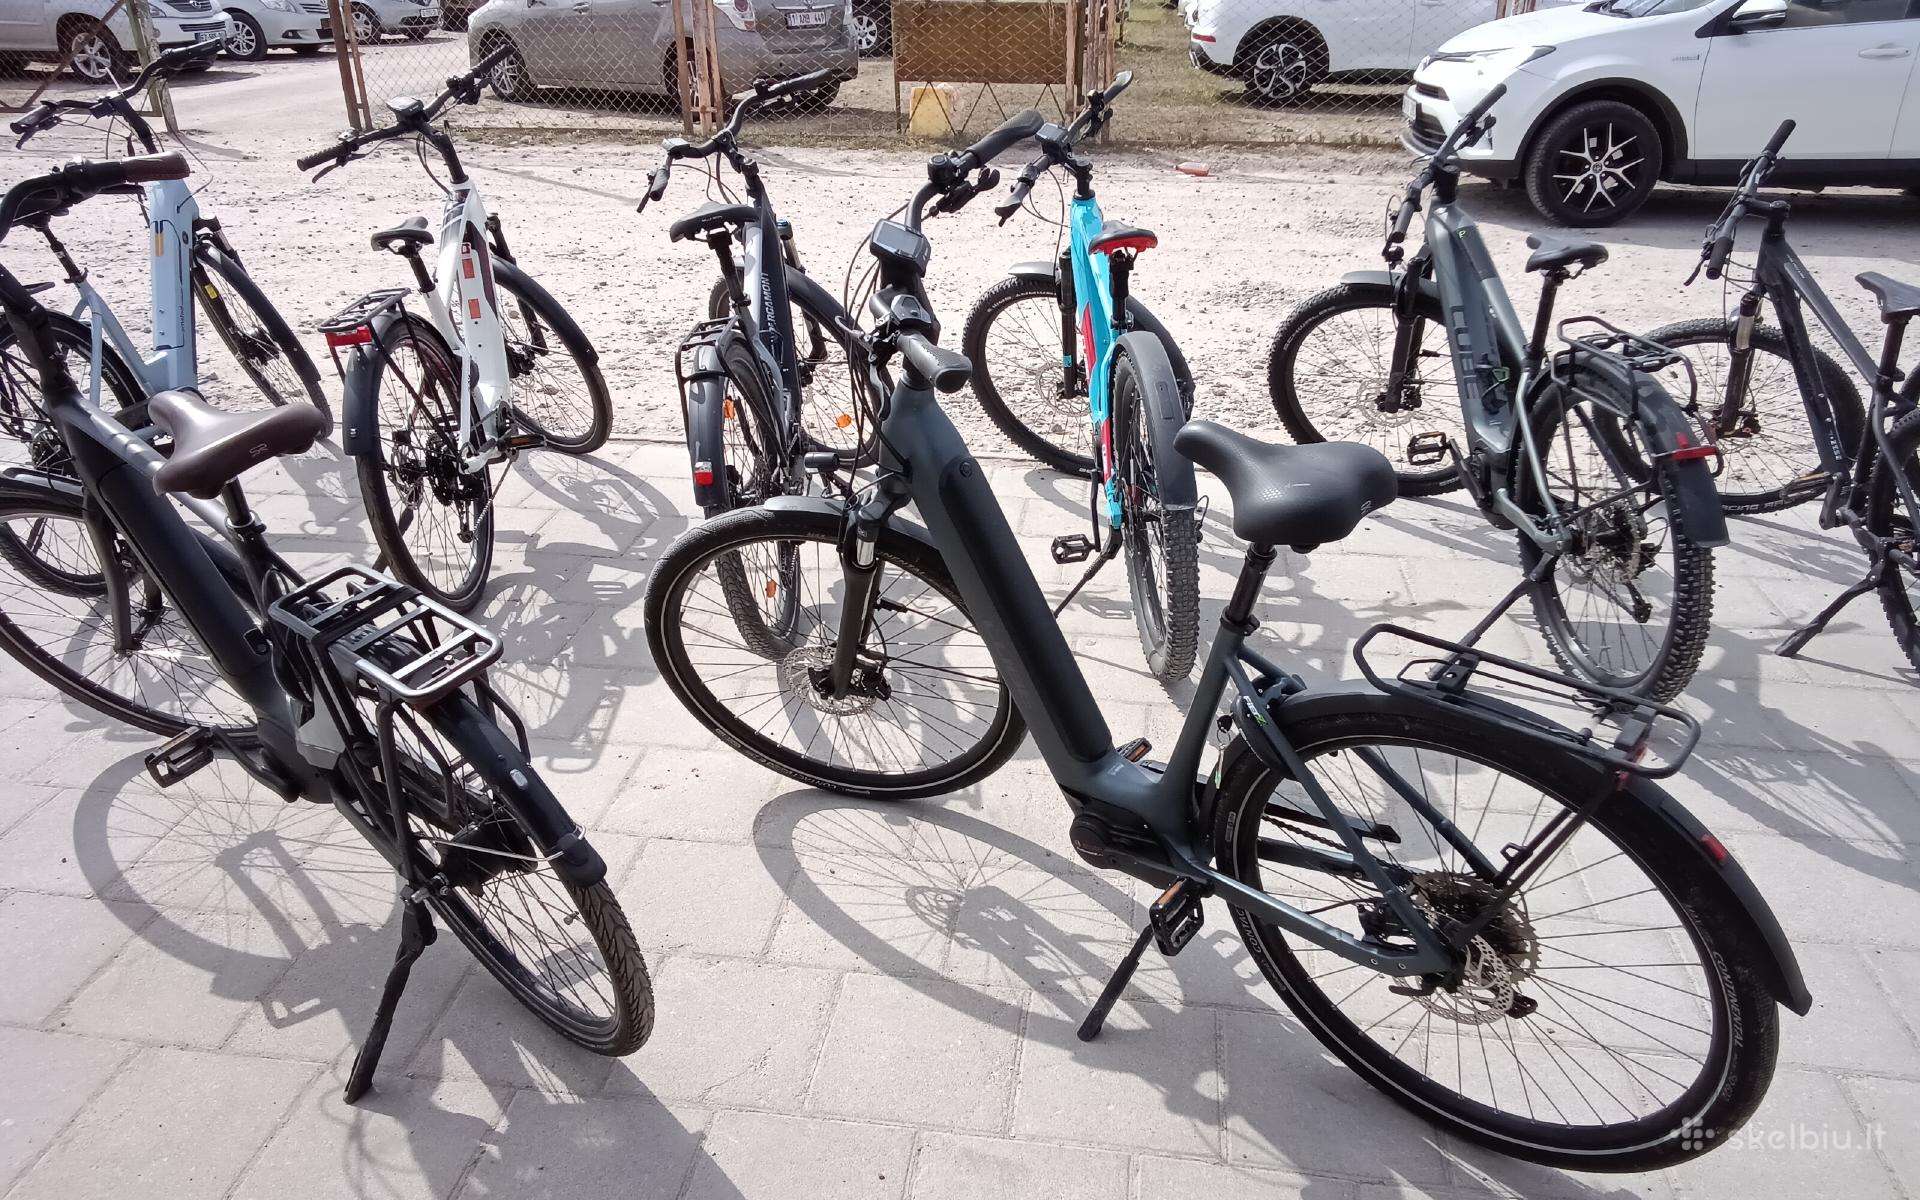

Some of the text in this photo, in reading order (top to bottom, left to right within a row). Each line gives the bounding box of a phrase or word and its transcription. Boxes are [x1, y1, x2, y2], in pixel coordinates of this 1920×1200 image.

[1449, 306, 1480, 399] CUBE
[1235, 905, 1262, 953] CONTAC
[1712, 951, 1744, 1048] CONTINENTAL
